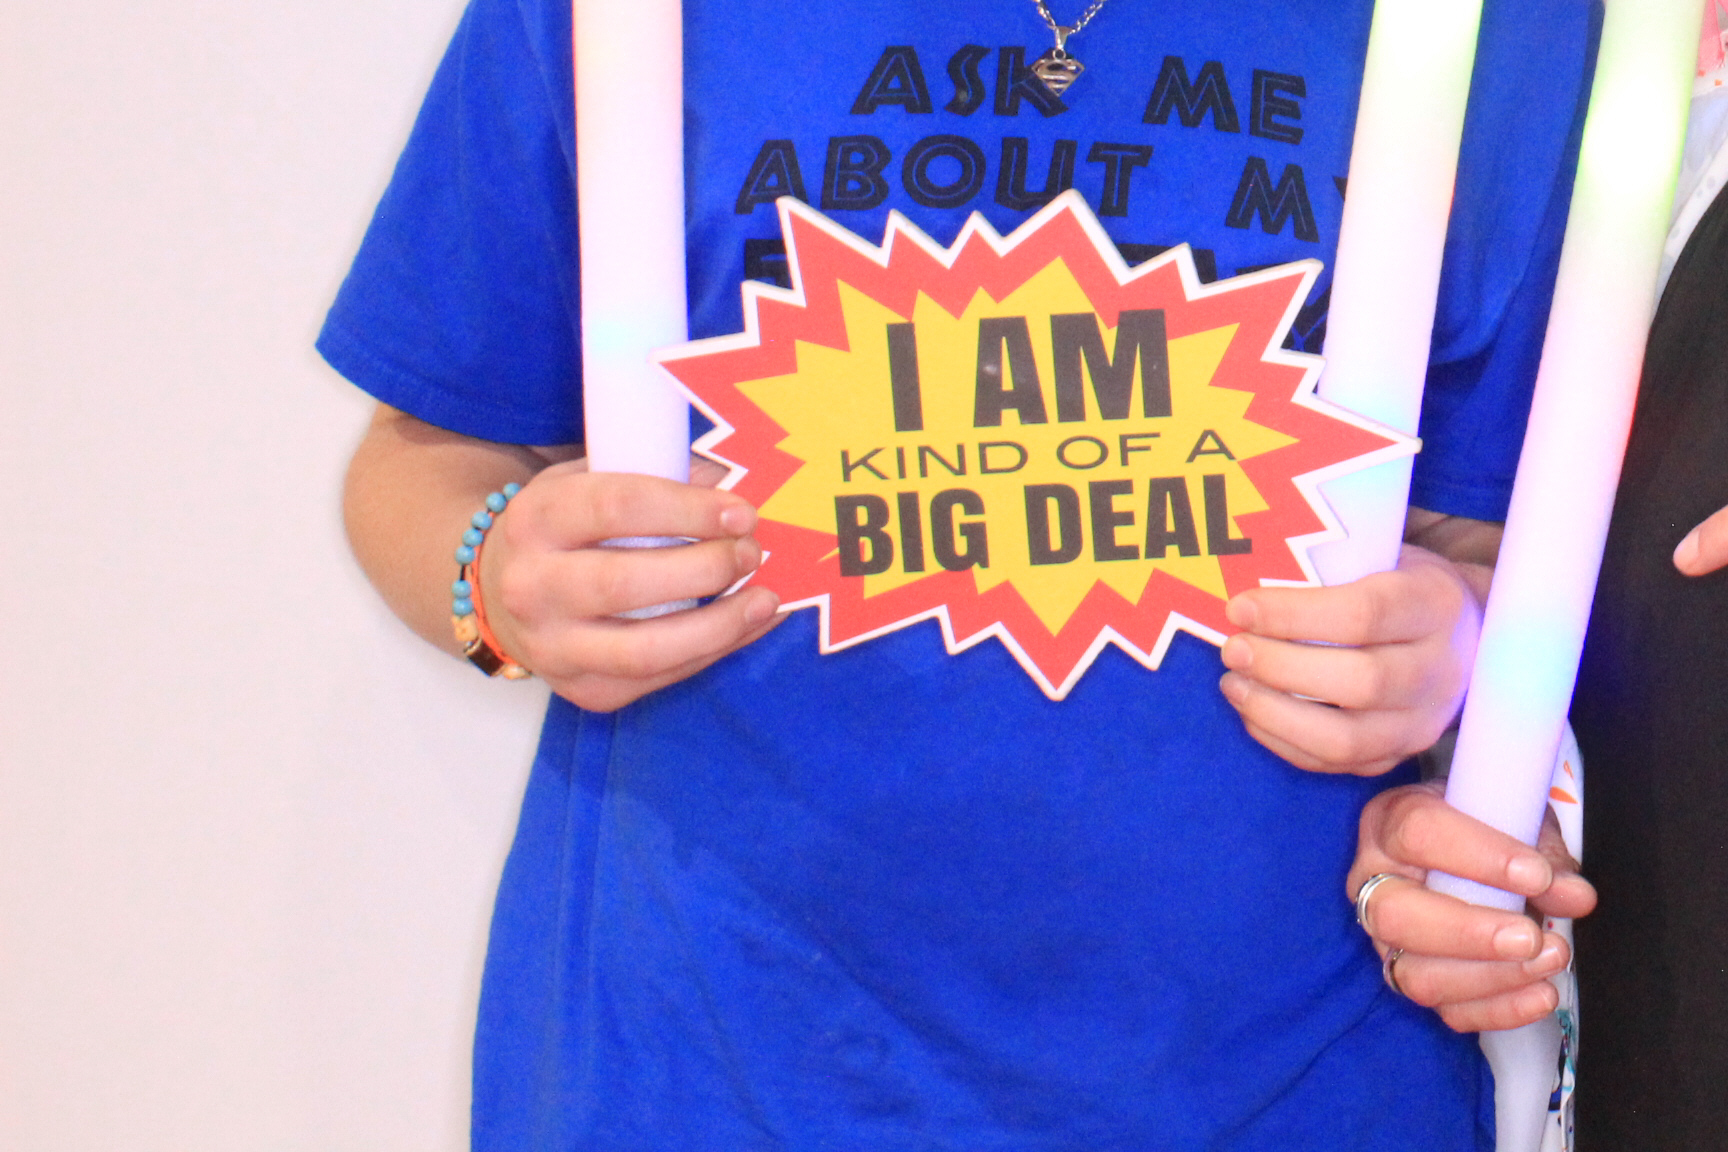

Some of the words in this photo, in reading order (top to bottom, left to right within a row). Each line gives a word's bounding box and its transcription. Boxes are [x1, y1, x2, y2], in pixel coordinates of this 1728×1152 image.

[850, 44, 1069, 117] ASK
[1142, 55, 1307, 145] ME
[735, 134, 1154, 218] ABOUT
[1224, 155, 1348, 243] M
[886, 322, 924, 432] I
[973, 309, 1172, 428] AM
[840, 441, 1028, 483] KIND
[1056, 432, 1161, 471] OF
[1186, 429, 1236, 464] A
[834, 488, 990, 577] BIG
[1023, 473, 1252, 567] DEAL
